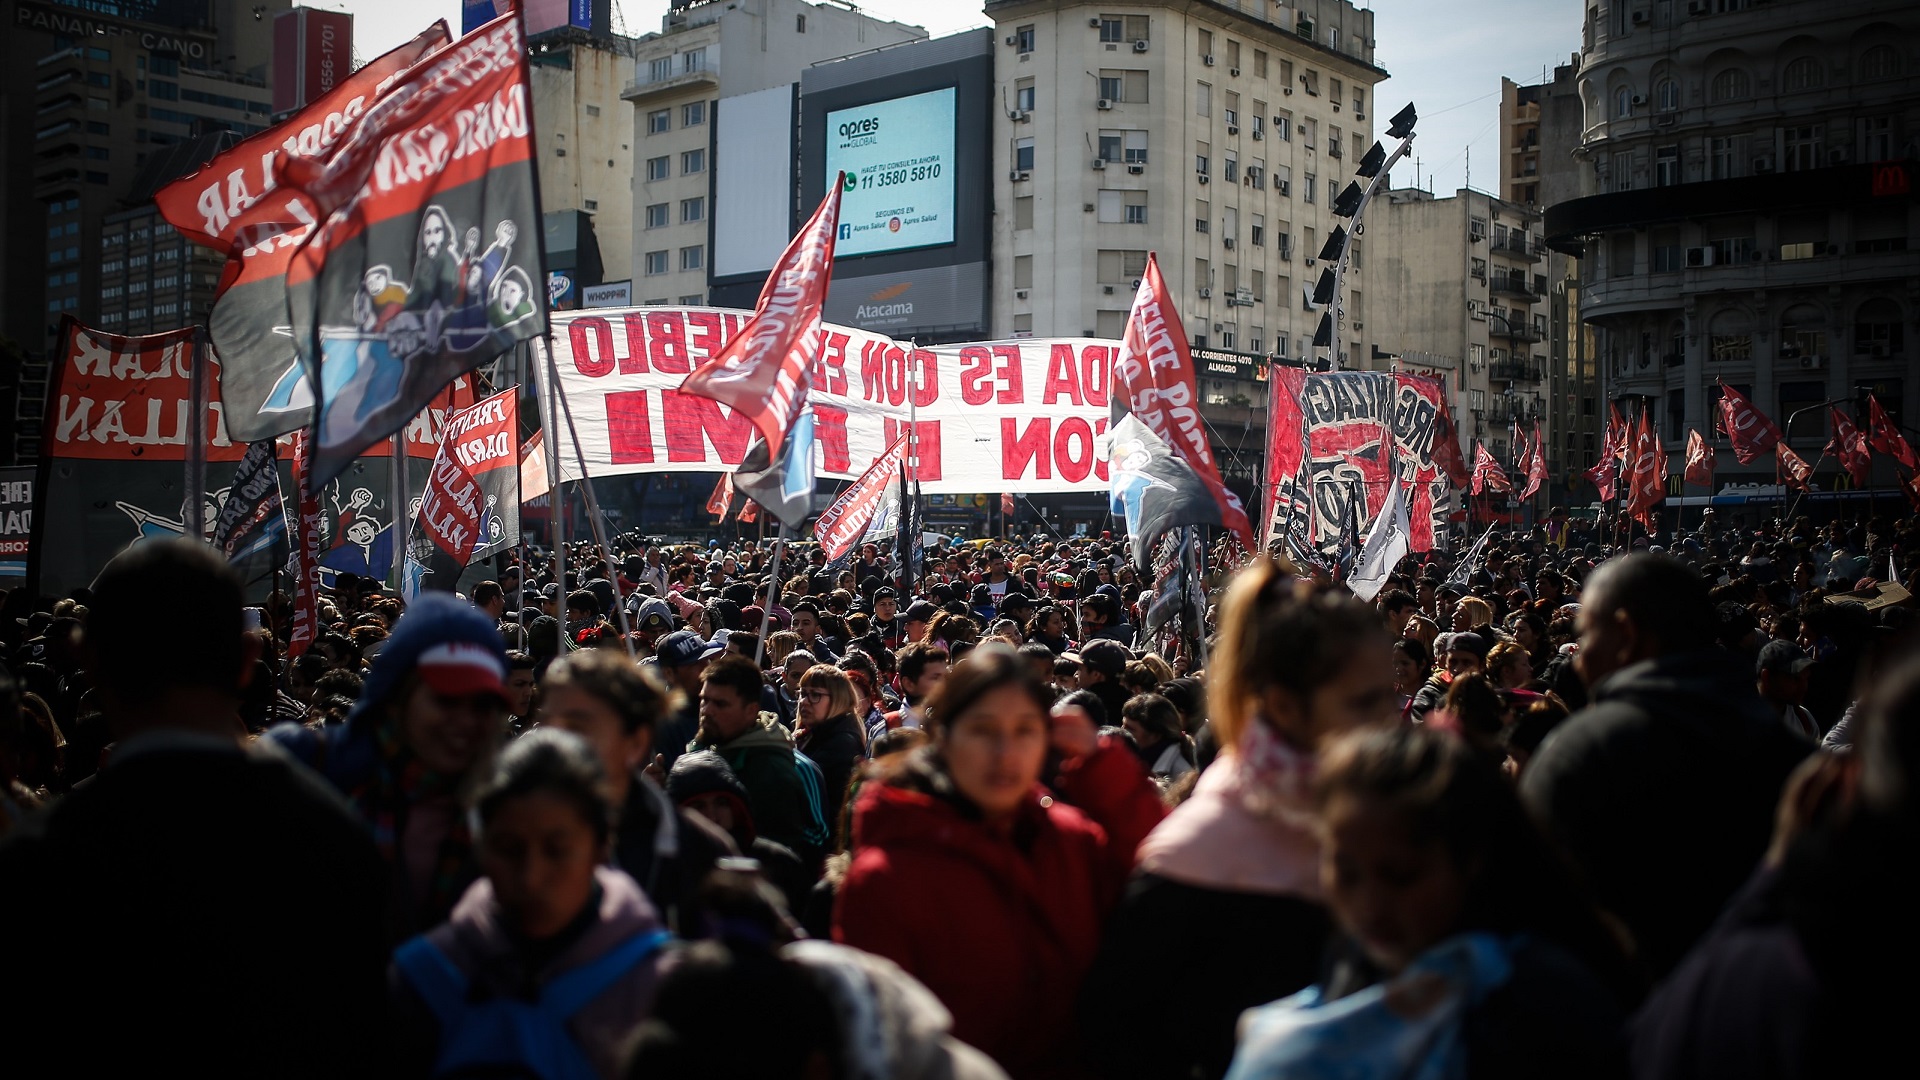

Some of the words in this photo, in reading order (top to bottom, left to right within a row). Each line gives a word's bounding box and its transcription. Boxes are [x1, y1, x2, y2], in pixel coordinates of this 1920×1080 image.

[838, 117, 879, 139] apres
[850, 137, 878, 149] GLOBAL
[878, 163, 886, 172] TU
[887, 159, 917, 170] CONSULTA
[917, 154, 941, 165] AHORA
[861, 175, 874, 189] 11
[877, 169, 907, 187] 3580
[910, 163, 941, 182] 5810
[875, 207, 905, 218] SEGUINOS
[906, 206, 915, 214] EN
[856, 302, 913, 319] Atacama
[1190, 348, 1201, 359] AV.
[1201, 350, 1237, 363] CORRIENTES
[1237, 354, 1253, 365] 4070
[1207, 362, 1237, 374] ALMAGRO
